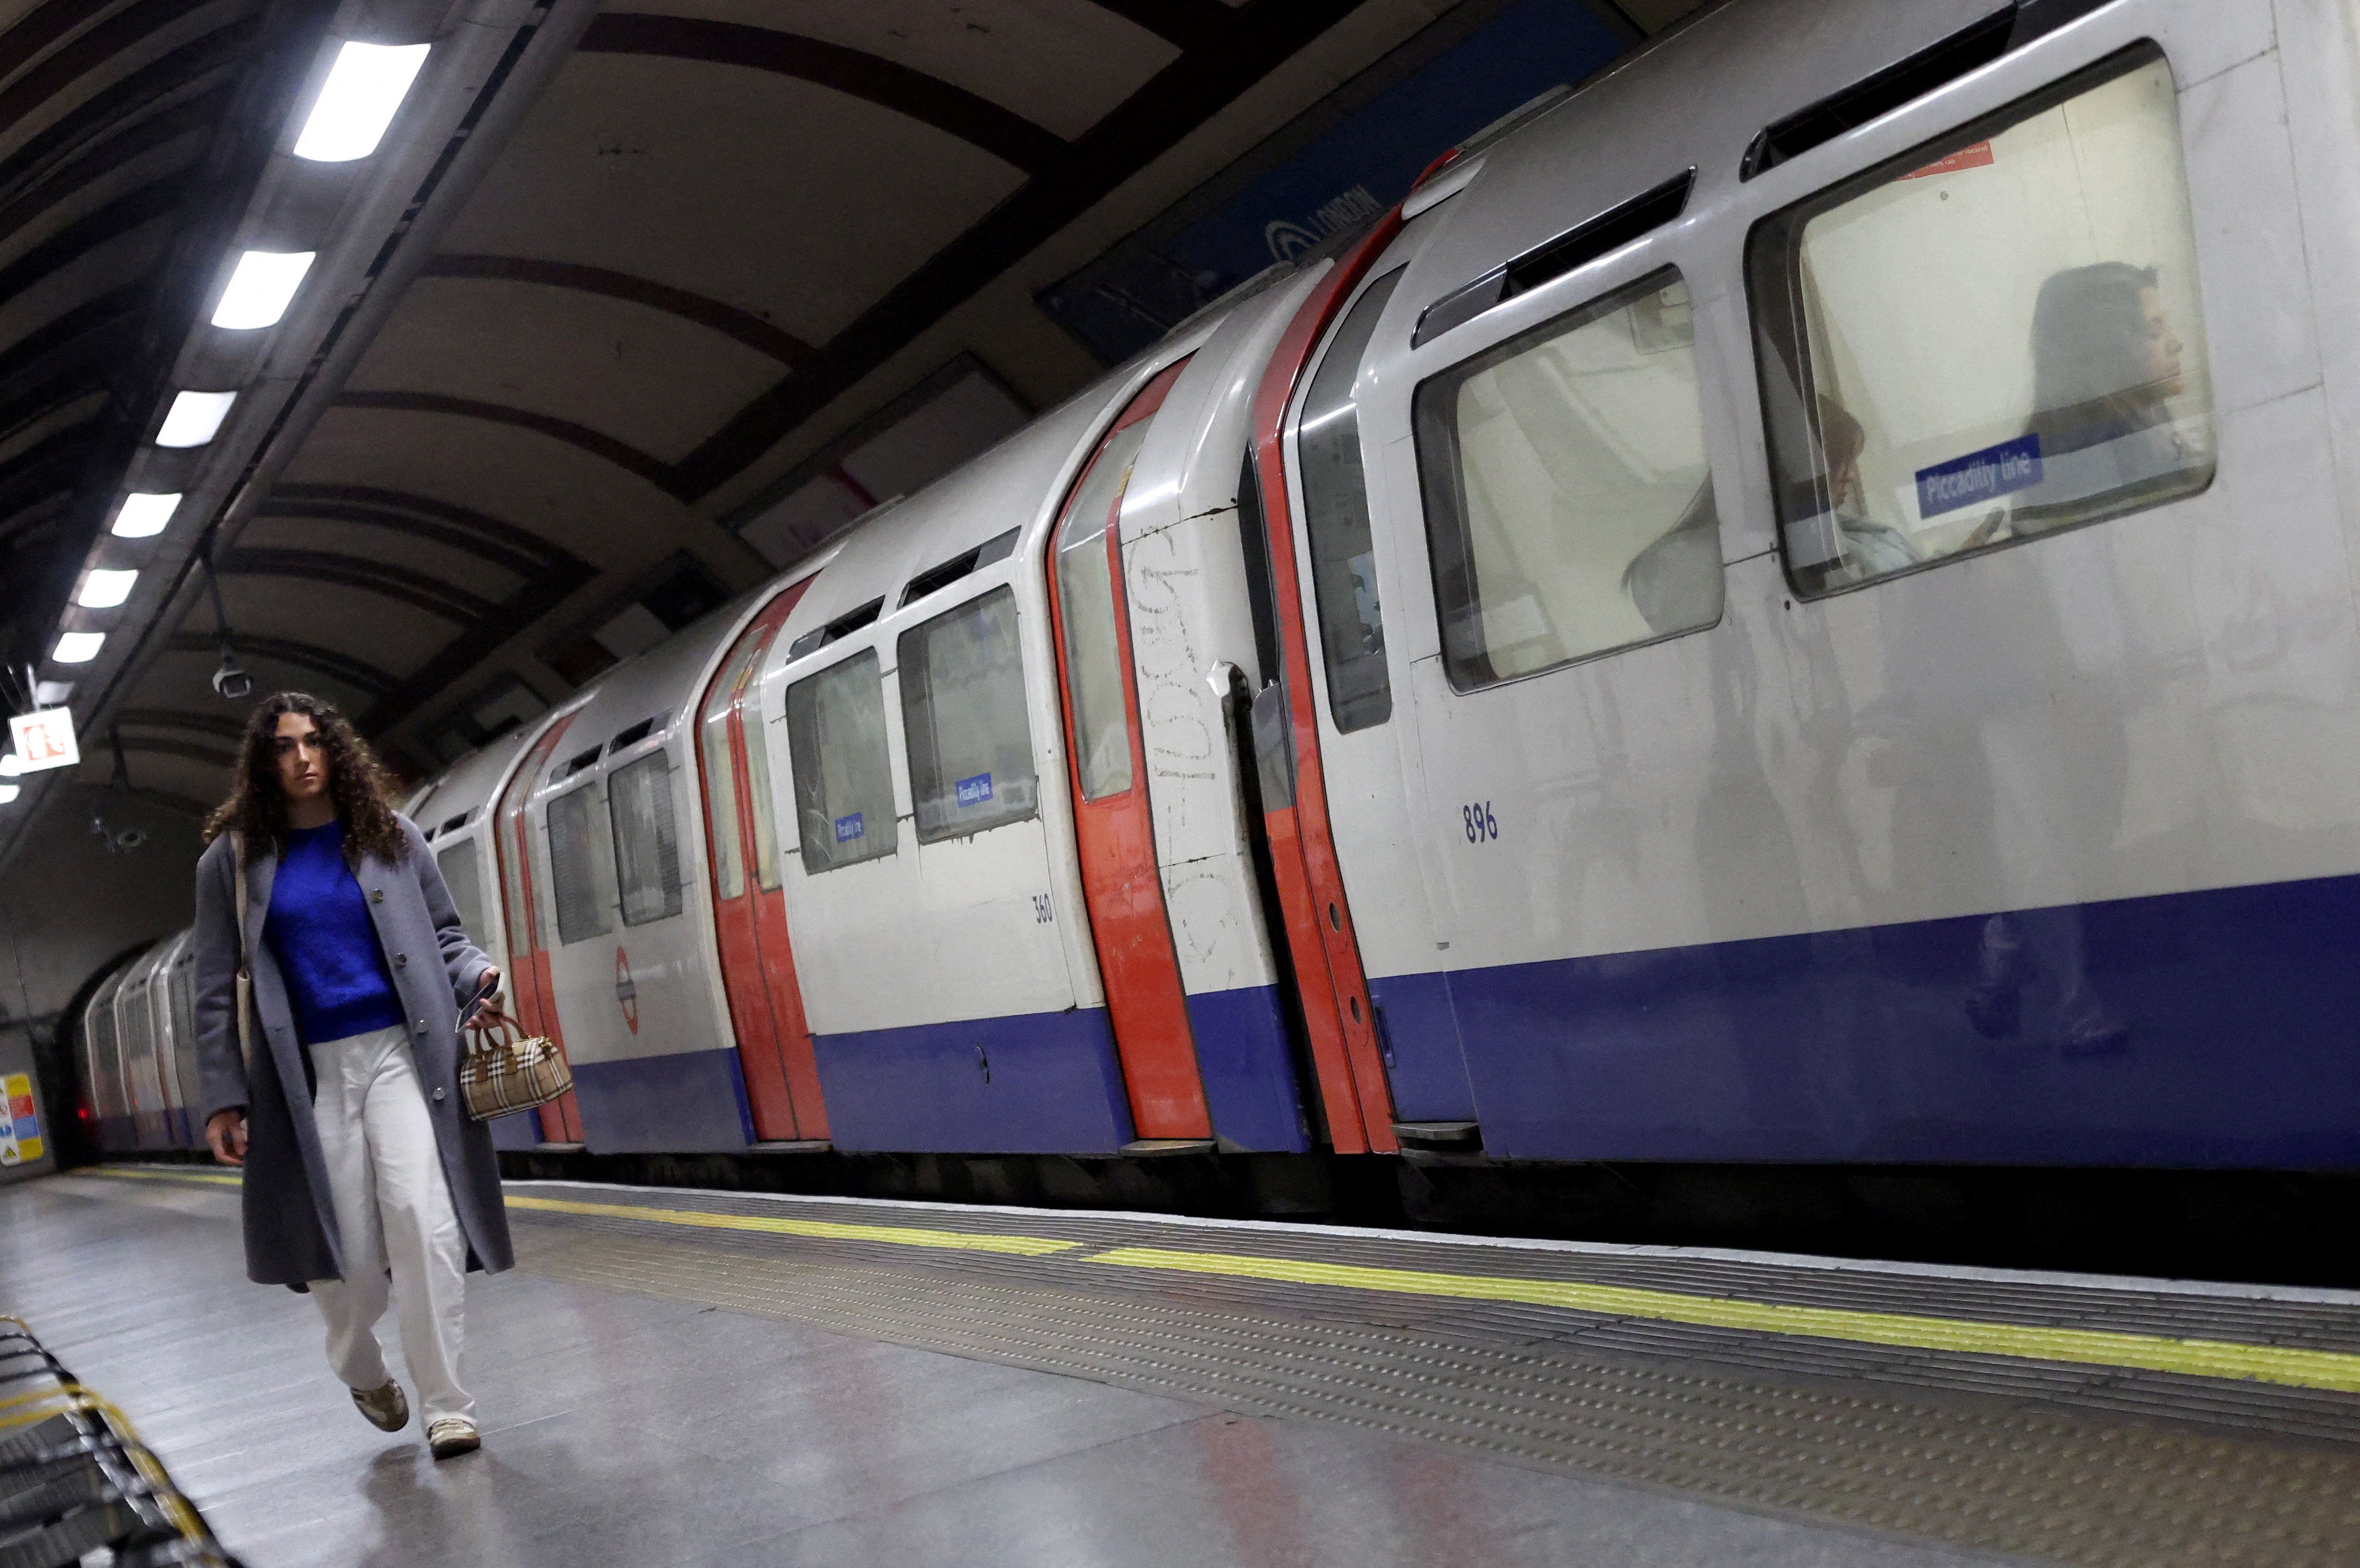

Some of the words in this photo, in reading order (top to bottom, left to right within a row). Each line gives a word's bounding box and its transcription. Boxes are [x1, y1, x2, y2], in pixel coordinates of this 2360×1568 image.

[1927, 457, 1998, 504] Piccadilly
[1999, 449, 2031, 481] line
[1463, 800, 1498, 844] 896
[1032, 892, 1052, 924] 360
